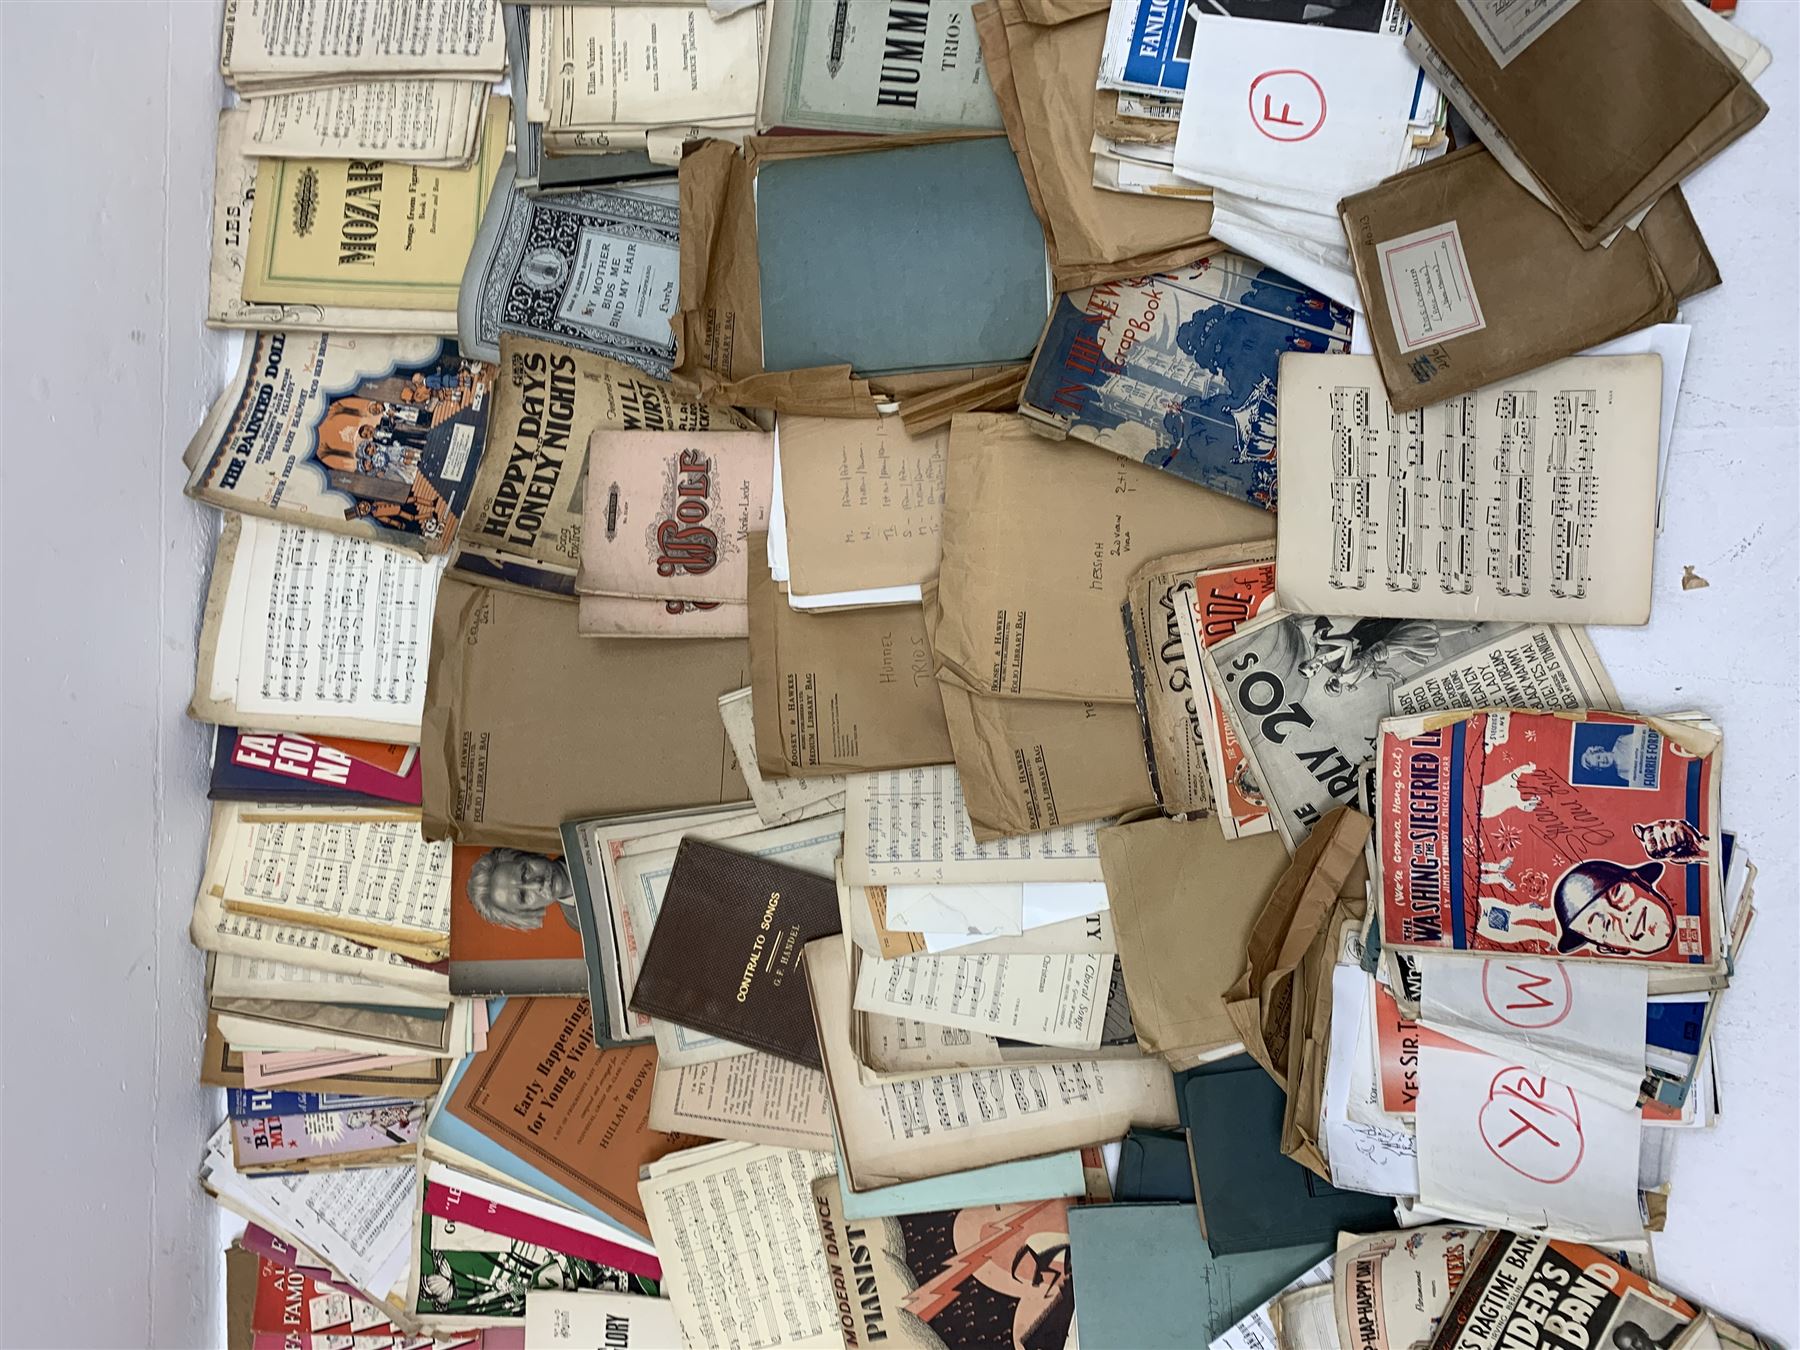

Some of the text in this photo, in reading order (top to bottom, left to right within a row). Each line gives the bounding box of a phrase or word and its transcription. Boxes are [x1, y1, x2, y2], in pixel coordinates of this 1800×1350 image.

[876, 0, 932, 110] HUMM
[940, 12, 960, 71] TRIOS
[1264, 94, 1304, 126] F
[226, 206, 240, 246] LES
[338, 158, 384, 266] MOZAR
[406, 198, 416, 220] from
[404, 222, 416, 252] Songs
[592, 242, 611, 294] MOTHER
[602, 258, 621, 309] BIDS ME
[610, 244, 637, 328] BIND MY HAIR
[1130, 290, 1164, 332] Book
[1064, 329, 1106, 376] THE
[1102, 328, 1138, 374] Scrap
[219, 458, 246, 490] THE
[236, 384, 274, 456] PAINTED
[264, 332, 286, 378] DOLL
[617, 378, 642, 432] WILL
[1050, 376, 1088, 412] IN
[482, 440, 536, 538] HAPPY
[517, 352, 546, 436] DAYS
[507, 451, 564, 548] LONELY
[542, 352, 577, 452] NIGHTS
[556, 528, 568, 553] Song
[1089, 542, 1104, 591] MESSIAH
[1234, 578, 1260, 590] of
[879, 632, 897, 684] HUMMEL
[910, 636, 930, 688] TRIOS
[990, 610, 1004, 692] BOOSEY HAWKES
[1010, 611, 1024, 694] FOLIO LIBRARY BAG
[1489, 649, 1519, 693] MY DREAMS
[1504, 648, 1531, 680] MAMMY
[1412, 686, 1432, 711] BIRD
[1425, 676, 1447, 707] CRAZY!
[1442, 676, 1459, 698] ROBIN
[1461, 666, 1489, 709] HEAVEN
[1477, 664, 1502, 694] LADY
[788, 674, 799, 767] BOOSEY HAWKES
[804, 672, 817, 766] MEDIUM LIBRARY BAG
[1398, 692, 1416, 715] BABY
[236, 734, 277, 768] FA
[460, 730, 470, 768] HAWKES
[1390, 746, 1405, 778] Out)
[1442, 755, 1450, 776] CARR
[1643, 756, 1658, 787] FLORRIE
[474, 732, 488, 822] FOLIO LIBRARY BAG
[1014, 749, 1038, 830] BOOSEY HAWKES
[1033, 745, 1056, 826] FOLIO LIBRARY BAG
[1390, 780, 1406, 814] Hang
[1408, 752, 1442, 842] SIEGFRIED
[1442, 779, 1450, 817] MICHAEL
[1392, 818, 1403, 863] Gonna
[1414, 843, 1424, 854] ON
[1424, 842, 1435, 856] THE
[1442, 830, 1450, 866] KENNEDY
[1409, 858, 1442, 942] WASHING
[1443, 868, 1451, 894] JIMMY
[736, 891, 781, 1002] CONTRALTO SONGS
[780, 923, 800, 965] HANDEL
[1402, 918, 1412, 941] THE
[1506, 965, 1555, 1010] W
[512, 1079, 544, 1118] Early
[536, 996, 590, 1077] Happenings
[527, 1066, 577, 1136] for Young
[599, 1104, 629, 1150] HULLAH
[622, 1059, 654, 1102] BROWN
[816, 1195, 858, 1349] MODERN DANCE
[845, 1224, 888, 1343] PIANIST
[1356, 1260, 1372, 1278] DAY
[283, 1268, 305, 1325] FAMO
[1468, 1269, 1518, 1340] RAGTIME
[1542, 1262, 1620, 1350] BAND
